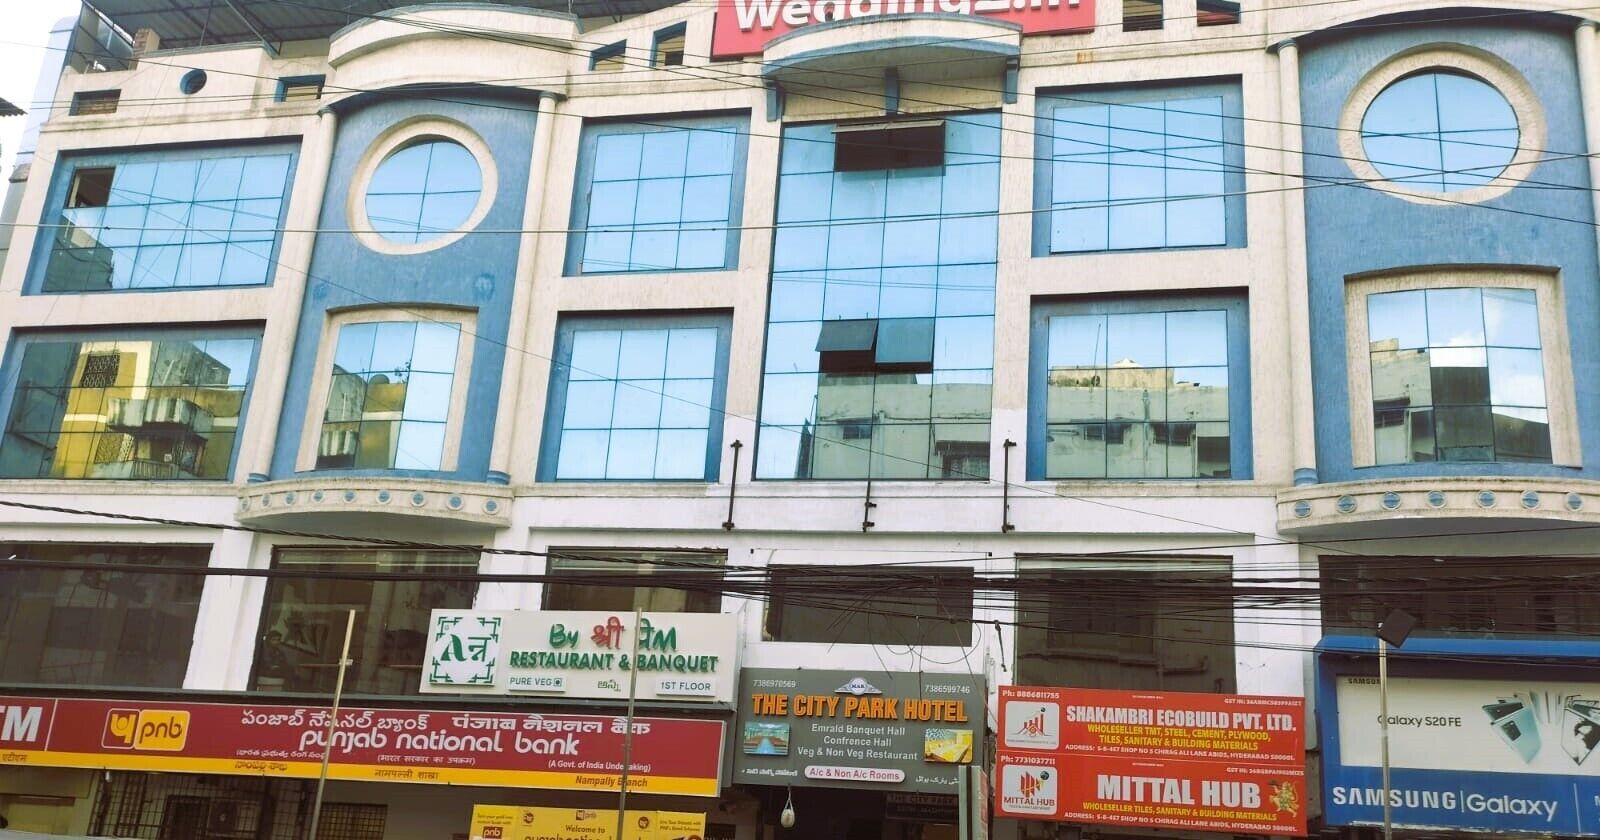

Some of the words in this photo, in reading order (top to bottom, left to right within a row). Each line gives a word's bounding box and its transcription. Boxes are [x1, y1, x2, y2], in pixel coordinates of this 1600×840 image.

[549, 623, 579, 648] By
[509, 651, 614, 671] RESTAURANT
[618, 653, 631, 671] &
[637, 654, 719, 673] BANQUET
[510, 677, 532, 686] PURE
[535, 678, 552, 687] VEG
[661, 681, 676, 690] 1ST
[679, 682, 712, 691] FLOOR
[925, 684, 971, 694] 7386599746
[1002, 690, 1015, 698] Ph:
[751, 694, 789, 716] THE
[792, 695, 841, 717] CITY
[843, 696, 899, 720] PARK
[902, 698, 969, 723] HOTEL
[240, 709, 306, 727] పంజాబ్
[377, 713, 430, 732] బ్యాంక్
[451, 714, 517, 731] पंजाब
[522, 713, 603, 733] नैशनल
[1066, 705, 1154, 725] SHAKAMBRI
[1156, 709, 1230, 729] ECOBUILD
[1232, 712, 1264, 730] PVT.
[1266, 714, 1297, 732] LTD.
[1425, 716, 1447, 727] S20
[1449, 717, 1462, 727] FE
[138, 716, 183, 745] pnb
[812, 723, 844, 734] Emrald
[846, 724, 885, 736] Banquet
[887, 725, 906, 737] Hall
[1087, 724, 1144, 735] WHOLESELLER
[1145, 726, 1163, 737] TMT,
[1164, 728, 1191, 739] STEEL,
[1192, 729, 1227, 740] CEMENT,
[1228, 731, 1272, 743] PLYWOOD,
[298, 727, 388, 754] punjab
[395, 729, 504, 753] national
[514, 731, 580, 756] bank
[823, 735, 872, 747] Confrence
[873, 737, 892, 748] Hall
[1065, 744, 1096, 752] ADDRESS:
[1121, 745, 1138, 753] SHOP
[1138, 746, 1149, 754] NO
[1098, 734, 1123, 746] TILES,
[1124, 735, 1163, 746] SANITARY
[1163, 737, 1171, 746] &
[1172, 738, 1211, 749] BUILDING
[1212, 740, 1259, 751] MATERIALS
[797, 746, 815, 758] Veg
[816, 747, 824, 757] &
[825, 748, 844, 758] Non
[846, 749, 864, 760] Veg
[866, 749, 919, 761] Restaurant
[1000, 755, 1014, 763] Ph:
[557, 760, 577, 769] Govt.
[577, 761, 586, 769] of
[586, 761, 604, 770] India
[605, 762, 651, 773] Undeaking)
[575, 775, 615, 788] Nampally
[617, 777, 648, 788] Banch
[809, 768, 824, 778] A/c
[825, 768, 832, 777] &
[834, 769, 852, 779] Non
[853, 769, 867, 779] A/c
[869, 770, 901, 781] Rooms
[1097, 774, 1195, 806] MITTAL
[1201, 780, 1261, 809] HUB
[1003, 796, 1036, 806] MITTAL
[1037, 798, 1055, 807] HUB
[1332, 786, 1457, 810] SAMSUNG
[1466, 794, 1558, 822] Galaxy
[1082, 802, 1134, 813] WHOLESELLER
[1134, 805, 1156, 815] TILES,
[1156, 806, 1191, 817] SANITARY
[1192, 809, 1199, 817] &
[1199, 809, 1235, 819] BUILDING
[1236, 811, 1278, 821] MATERIALS
[1064, 811, 1095, 820] ADDRESS:
[1231, 822, 1272, 831] HYDERABAD
[565, 825, 597, 834] Welcome
[598, 827, 606, 835] to
